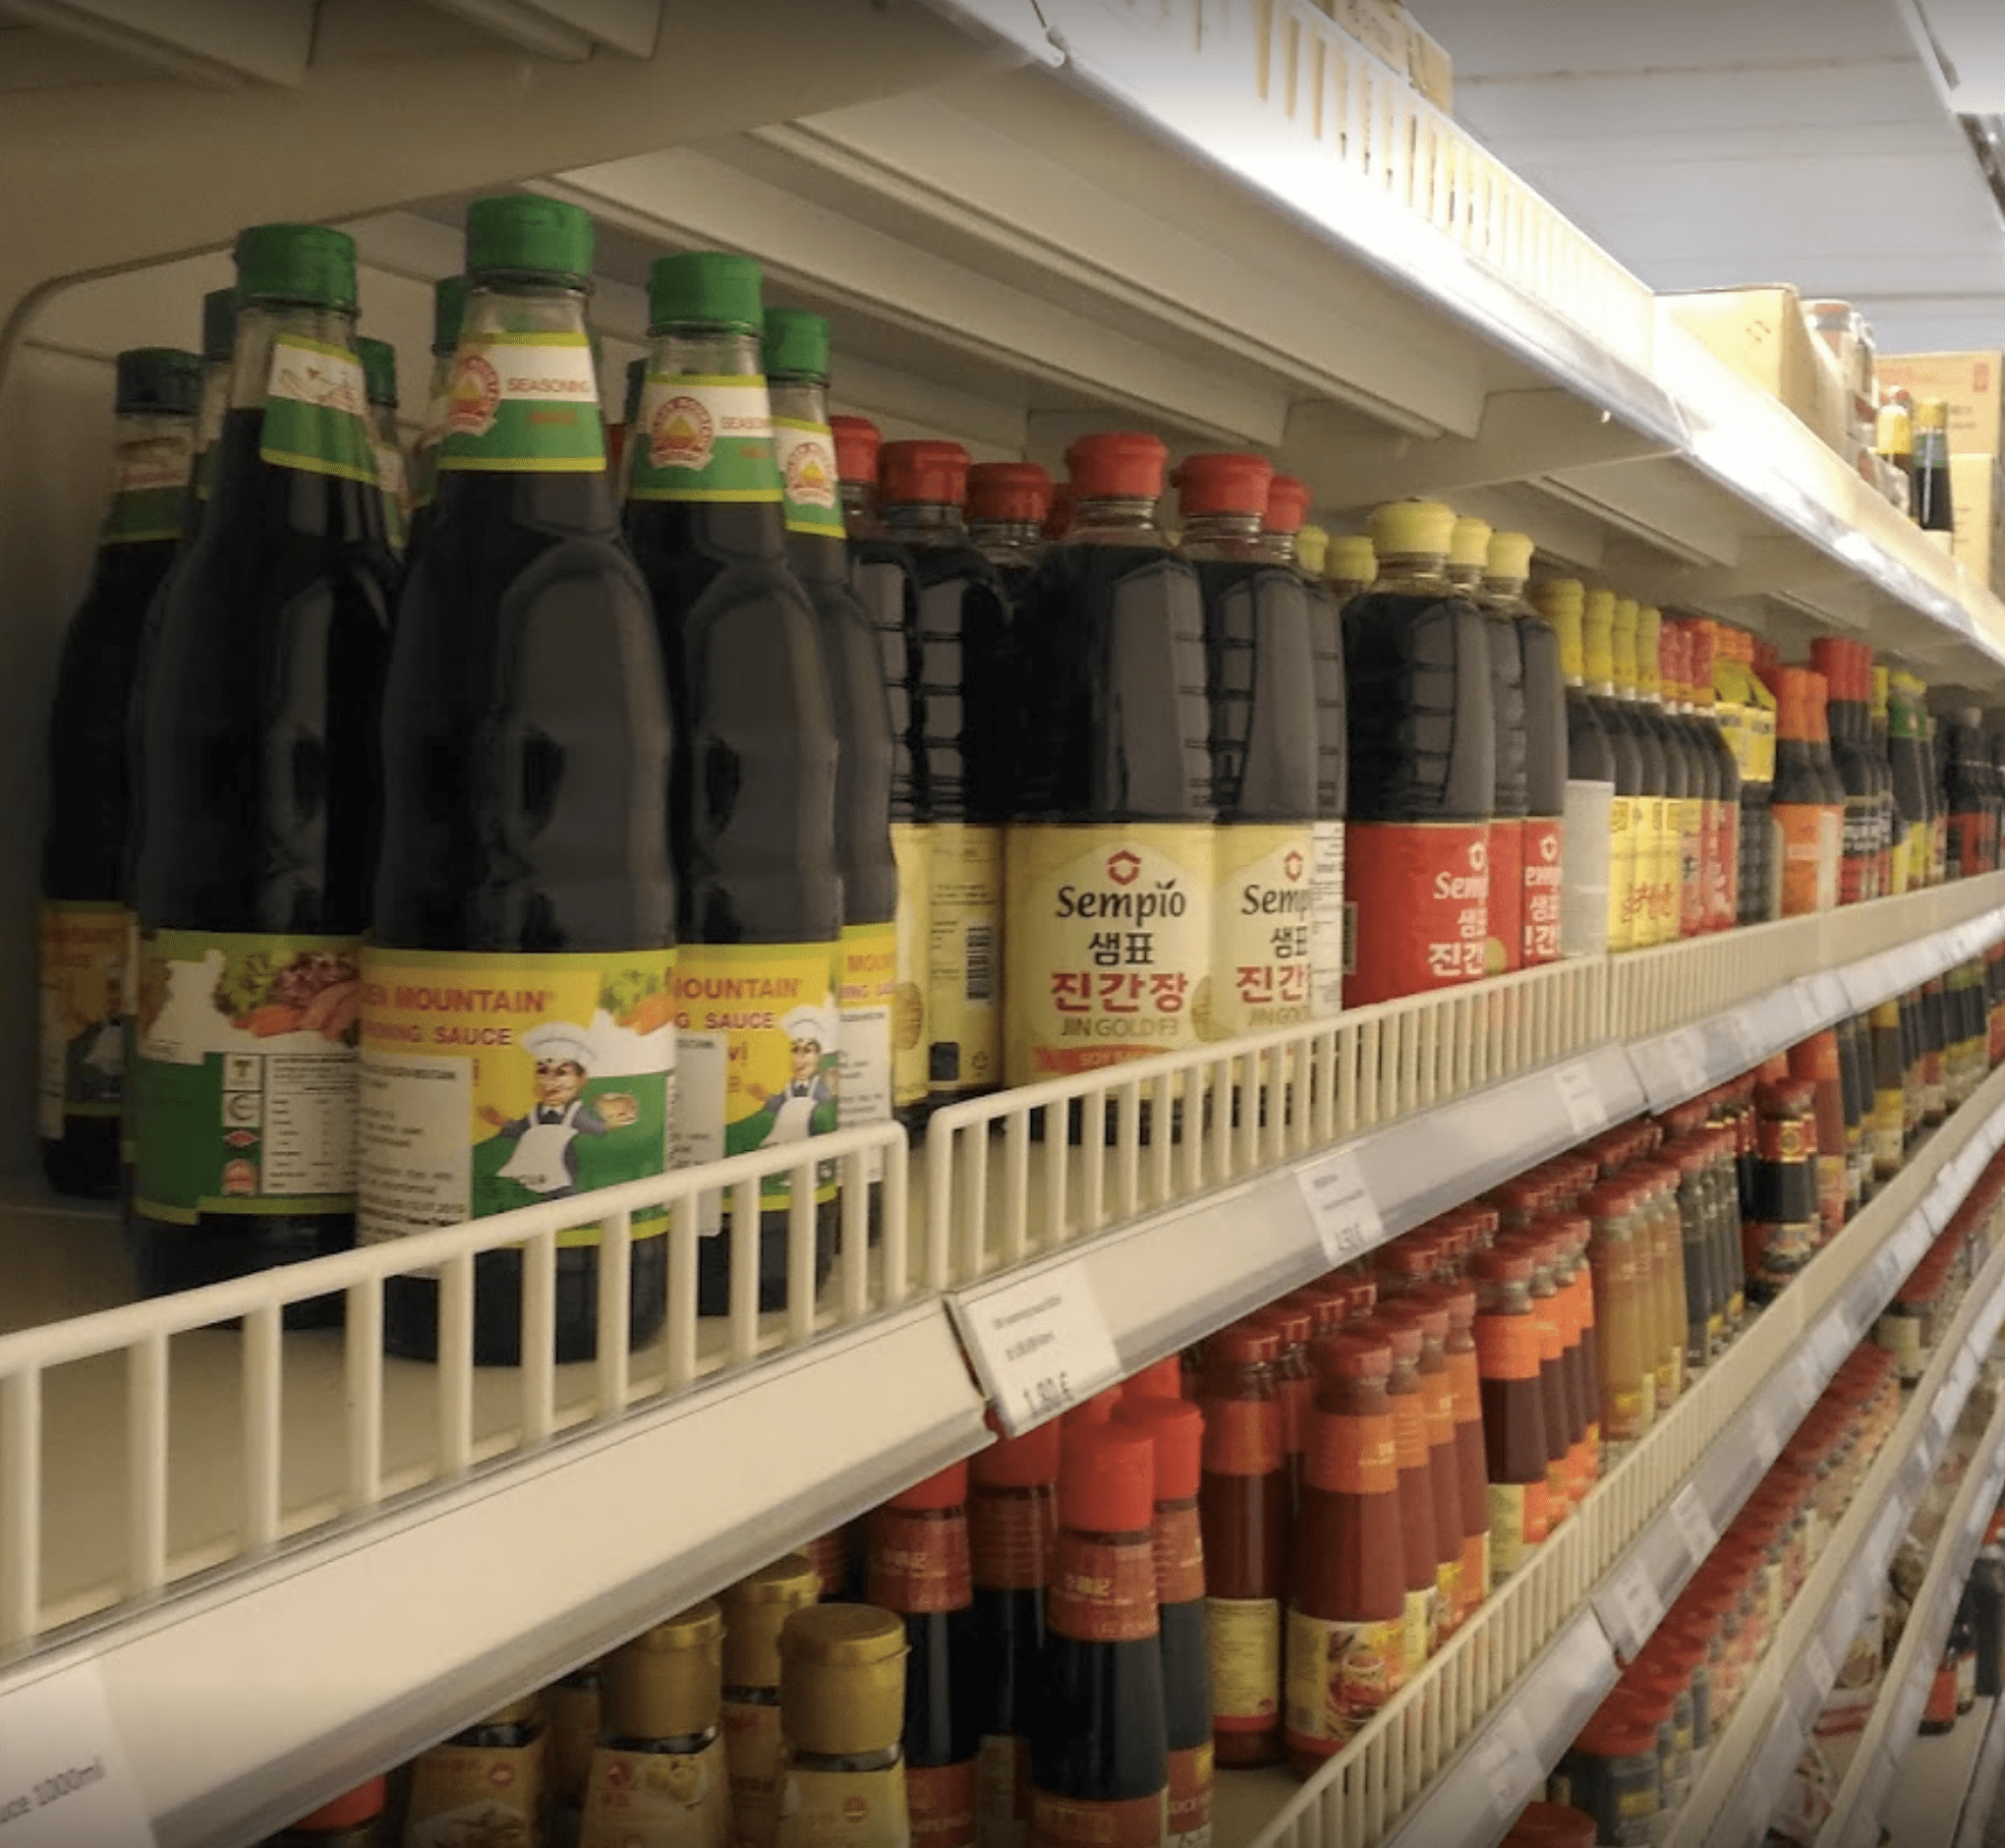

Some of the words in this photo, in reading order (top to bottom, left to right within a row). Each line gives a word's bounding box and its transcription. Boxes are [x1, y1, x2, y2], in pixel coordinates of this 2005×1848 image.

[1055, 878, 1186, 928] Sempio
[1088, 932, 1154, 967] 샘표
[394, 985, 544, 1013] MOUNTAIN
[1051, 971, 1188, 1013] 진간장
[433, 1025, 514, 1046] SAUCE
[705, 1011, 776, 1029] SAUCE
